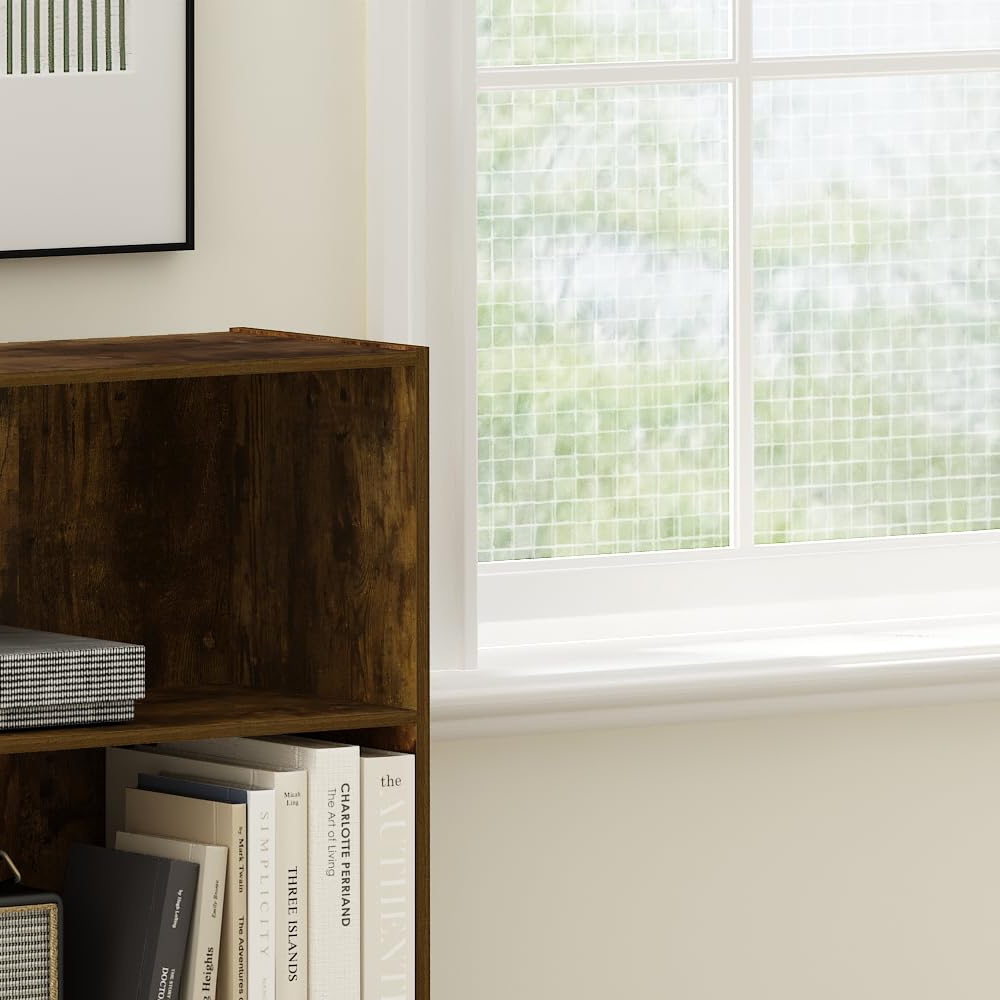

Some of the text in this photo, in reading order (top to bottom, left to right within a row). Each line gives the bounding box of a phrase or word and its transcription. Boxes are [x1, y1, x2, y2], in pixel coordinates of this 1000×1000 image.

[380, 775, 402, 787] the
[325, 788, 337, 877] The Art of Living
[340, 782, 351, 927] CHARLOTTE PERRIAND
[259, 810, 270, 957] SIMPLICITY
[287, 866, 298, 982] THREE ISLANDS
[166, 980, 174, 999] STORY
[202, 946, 214, 992] Heights
